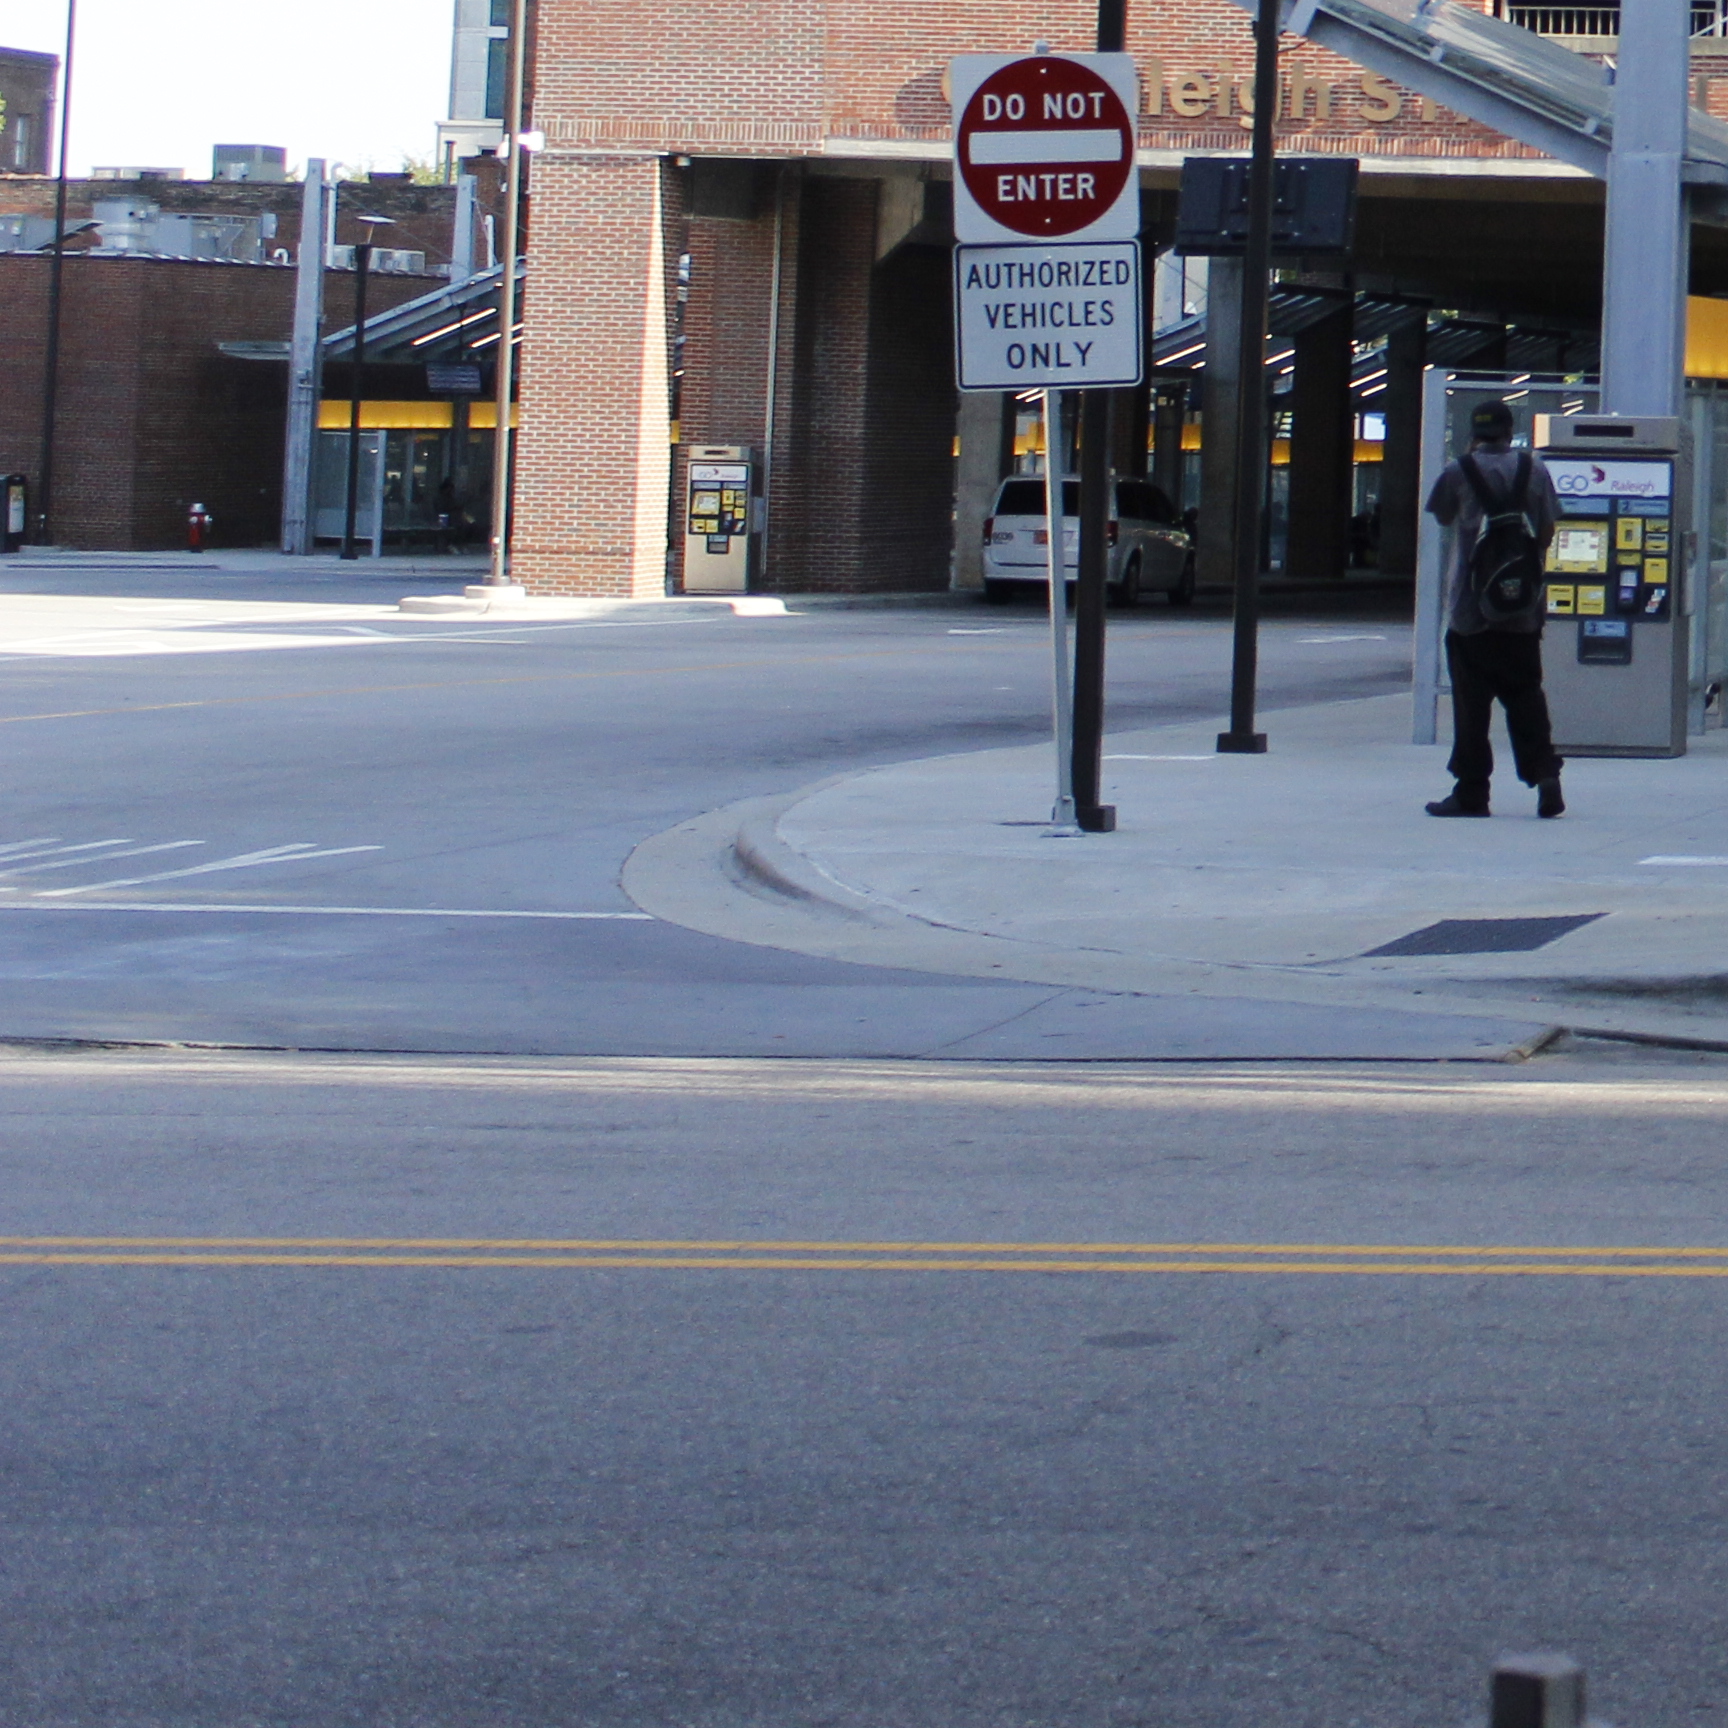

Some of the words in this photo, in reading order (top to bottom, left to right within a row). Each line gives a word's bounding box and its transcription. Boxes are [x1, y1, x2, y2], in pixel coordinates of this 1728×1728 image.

[982, 93, 1026, 121] DO
[1043, 91, 1106, 120] NOT
[997, 172, 1096, 202] ENTER
[966, 259, 1130, 290] AUTHORIZED
[984, 299, 1115, 330] VEHICLES
[1006, 340, 1094, 370] ONLY
[1557, 474, 1589, 492] GO
